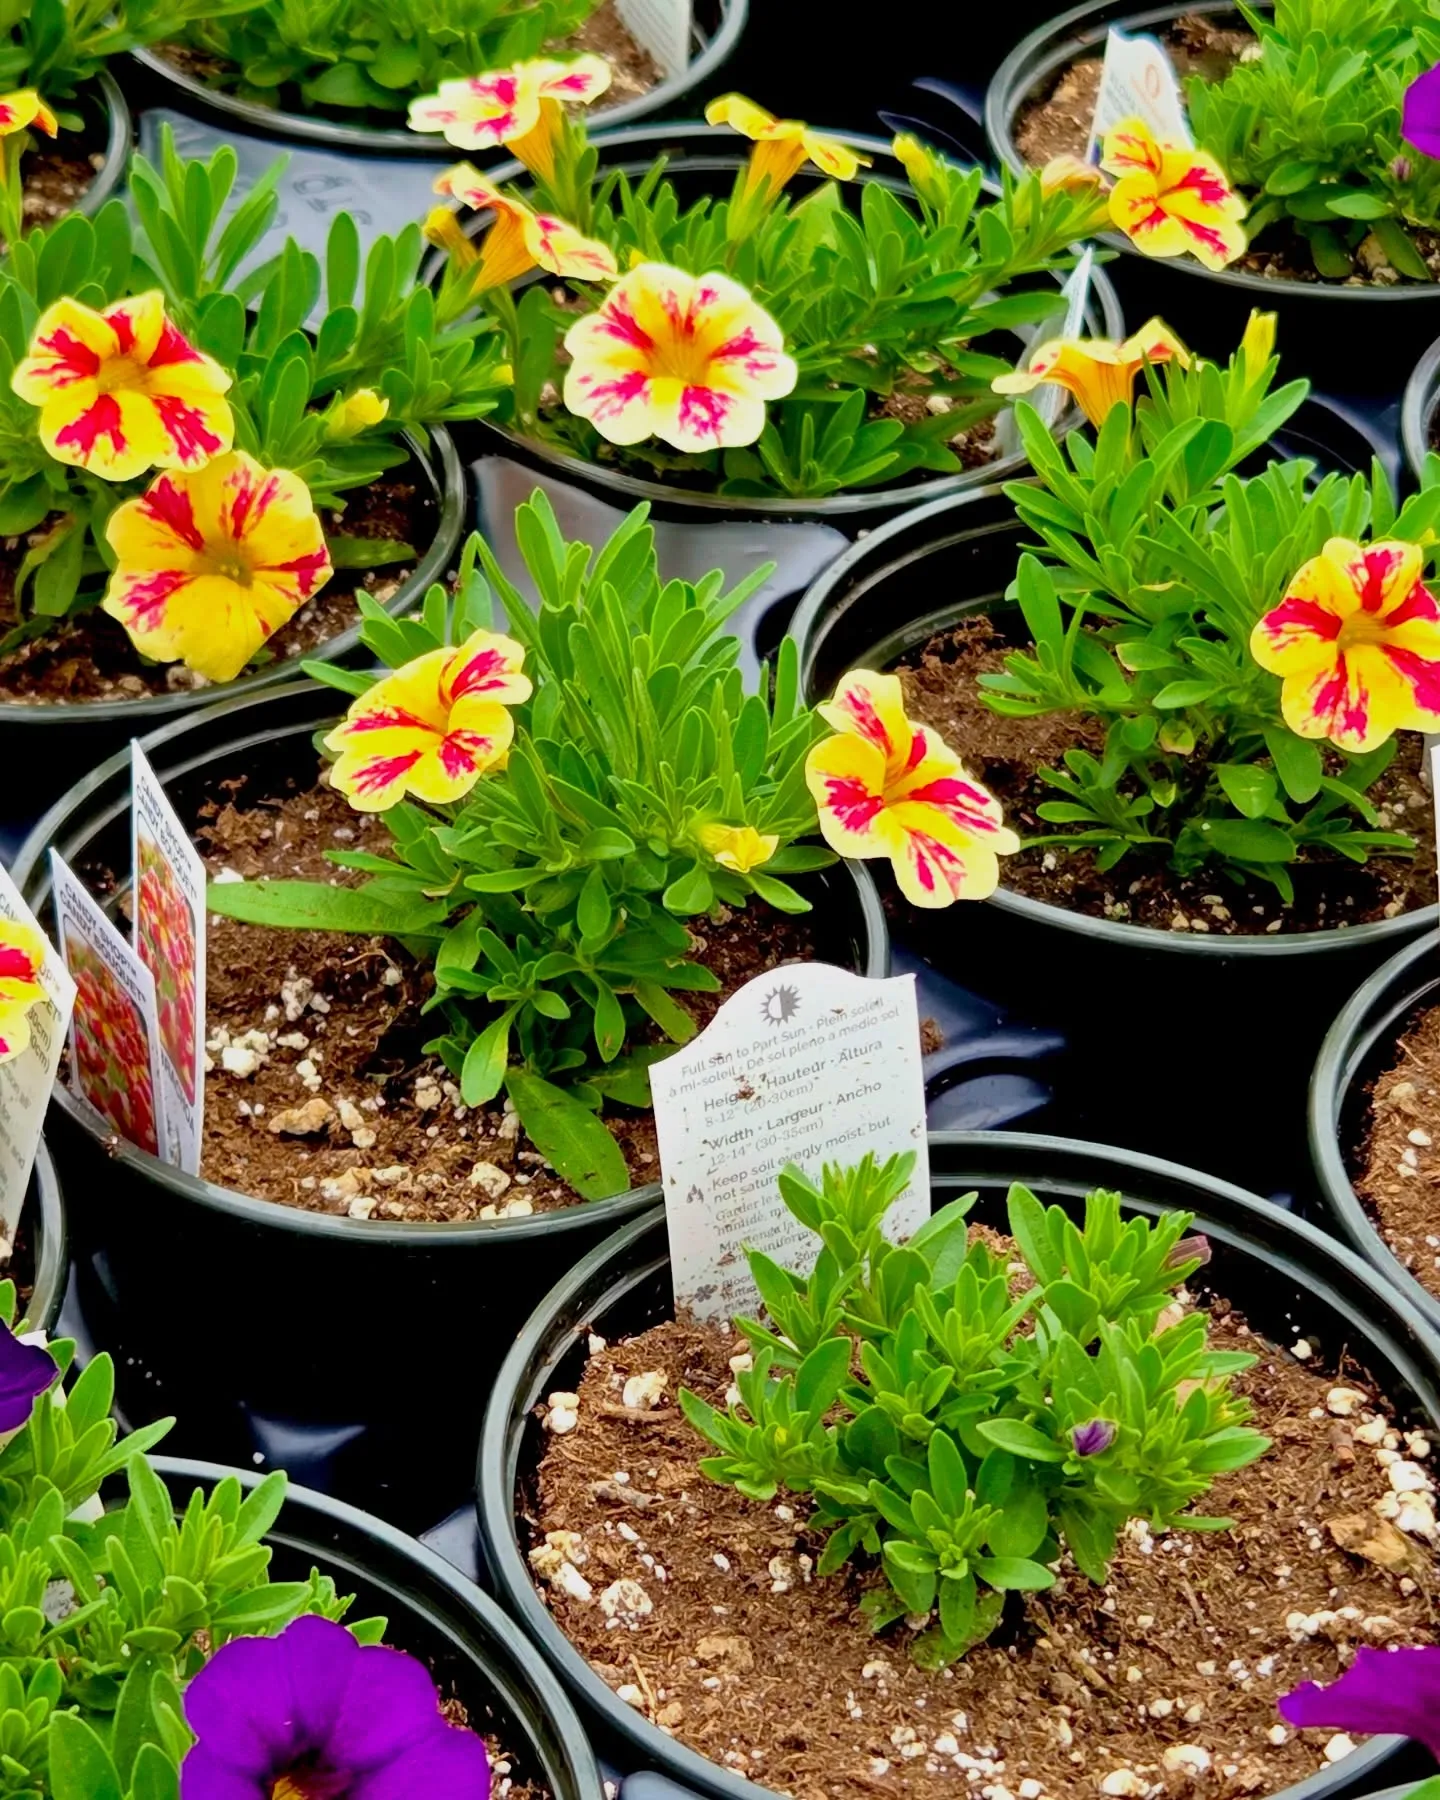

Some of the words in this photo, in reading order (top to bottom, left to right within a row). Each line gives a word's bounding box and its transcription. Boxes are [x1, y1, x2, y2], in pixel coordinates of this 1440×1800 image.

[60, 890, 92, 935] CANDY
[65, 883, 97, 928] CANDY
[680, 1065, 737, 1094] mi-soleil
[747, 1057, 765, 1071] De
[768, 1048, 787, 1062] sol
[789, 1036, 826, 1058] pleno
[828, 1031, 836, 1041] a
[838, 1014, 879, 1038] medio
[881, 1006, 900, 1022] sol
[681, 1060, 707, 1078] Full
[708, 1052, 733, 1068] Sun
[736, 1048, 750, 1059] to
[752, 1035, 778, 1053] Part
[781, 1027, 806, 1042] Sun
[816, 1011, 848, 1029] Plein
[850, 997, 884, 1018] soleil
[766, 1060, 826, 1090] Hauteur
[838, 1040, 883, 1063] Altura
[707, 1127, 754, 1151] Width
[766, 1101, 824, 1131] Largeur
[836, 1081, 882, 1105] Ancho
[755, 1116, 824, 1152] (30-35cm)
[712, 1170, 748, 1191] Keep
[751, 1158, 776, 1176] soil
[778, 1143, 822, 1166] evenly
[868, 1116, 891, 1132] but
[714, 1187, 737, 1204] not
